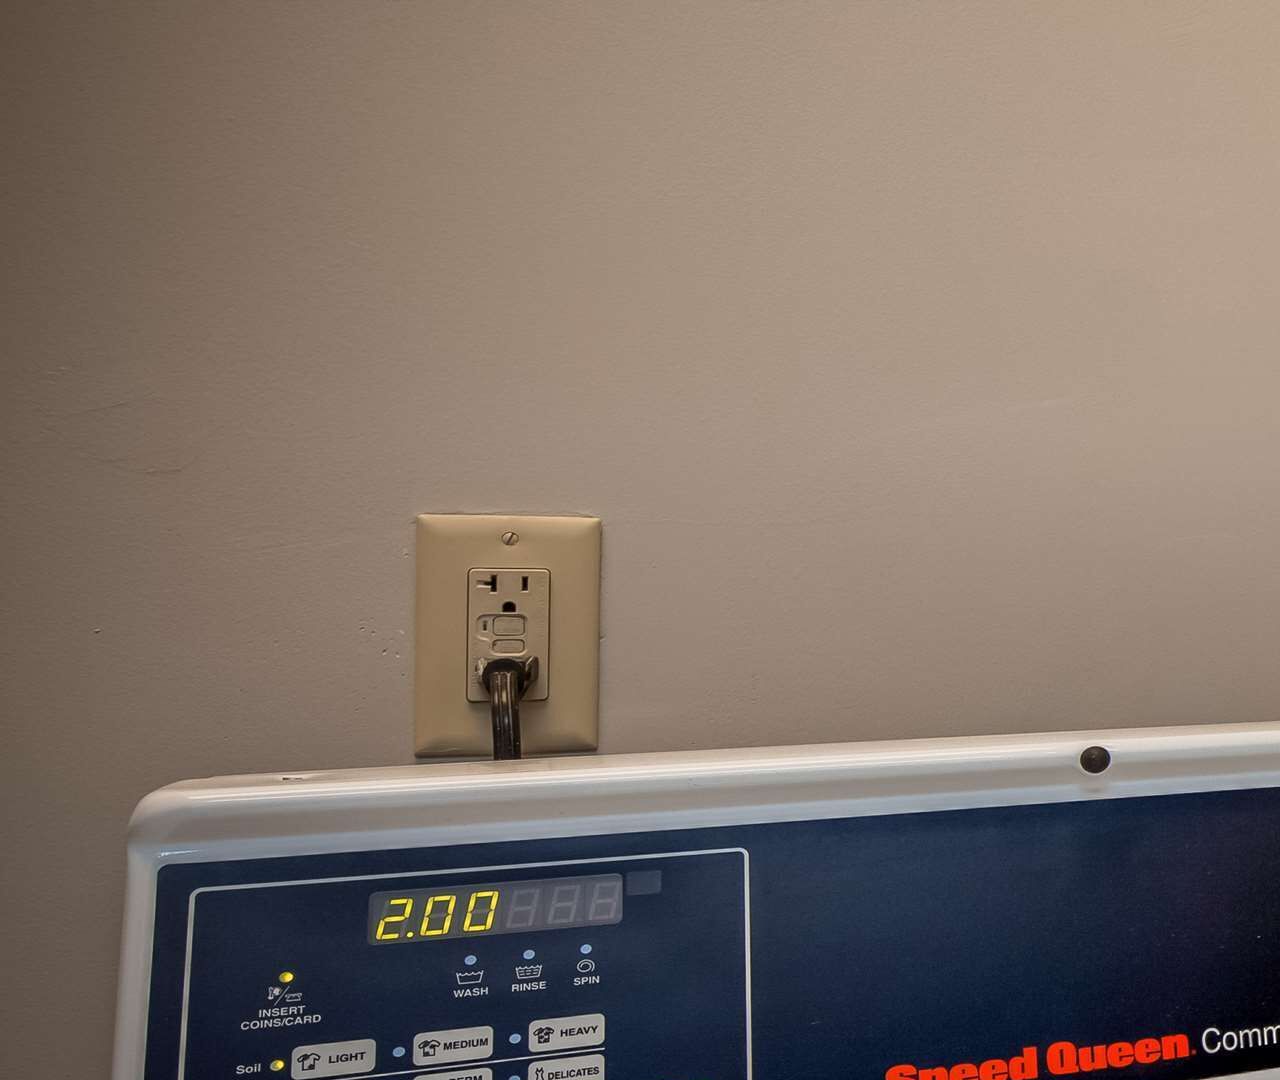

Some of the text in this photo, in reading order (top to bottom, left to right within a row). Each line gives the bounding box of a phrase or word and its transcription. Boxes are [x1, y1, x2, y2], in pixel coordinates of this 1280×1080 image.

[376, 890, 499, 941] 2.00
[511, 981, 547, 992] RINSE
[573, 975, 600, 986] SPIN
[453, 986, 489, 998] WASH
[258, 1005, 306, 1018] INSERT
[240, 1014, 322, 1031] COINS/CARD
[560, 1025, 599, 1038] HEAVY
[443, 1037, 489, 1051] MEDIUM
[328, 1051, 367, 1064] LIGHT
[1046, 1033, 1190, 1075] Queen
[235, 1063, 262, 1075] Soil
[547, 1066, 600, 1080] DELICATES
